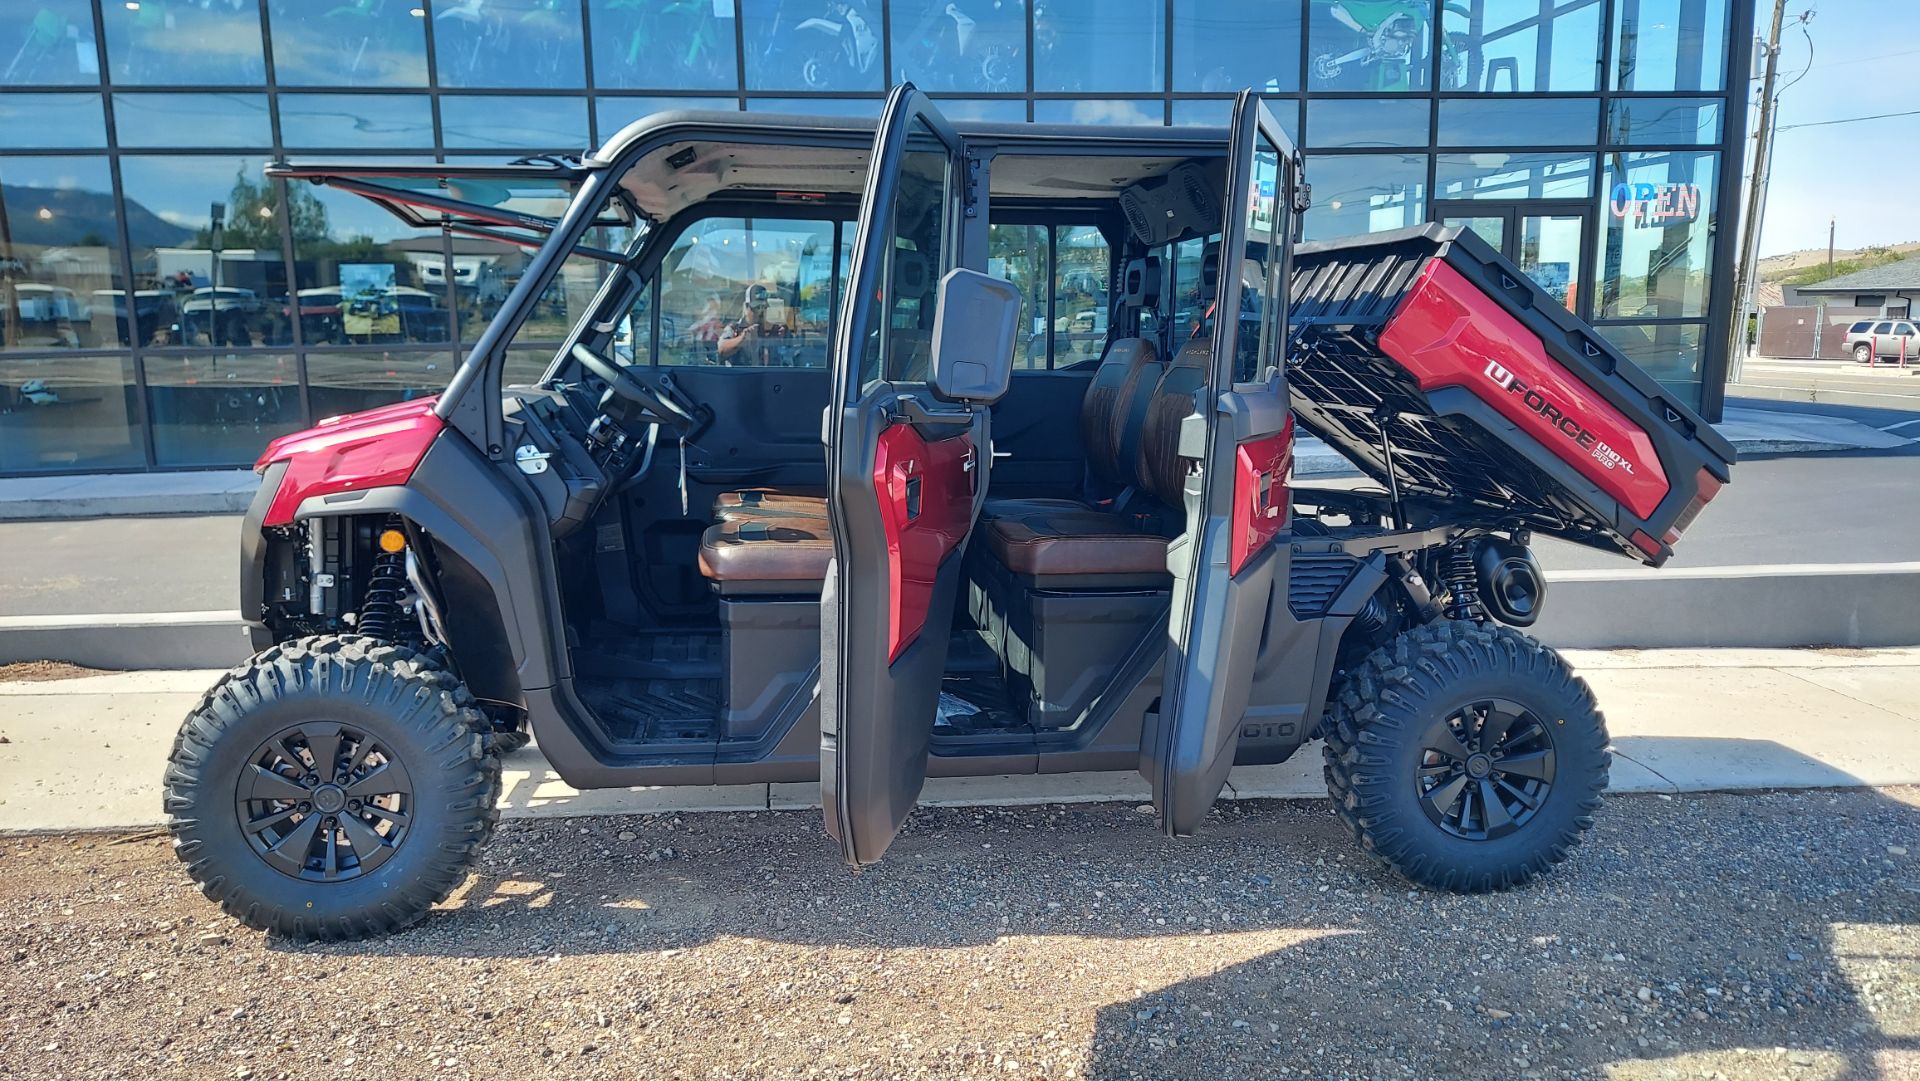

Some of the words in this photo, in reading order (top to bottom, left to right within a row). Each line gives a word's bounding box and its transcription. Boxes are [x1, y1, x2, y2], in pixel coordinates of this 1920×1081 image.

[1611, 182, 1698, 219] OPEN
[1592, 449, 1616, 470] PRO
[1240, 722, 1296, 738] OTO
